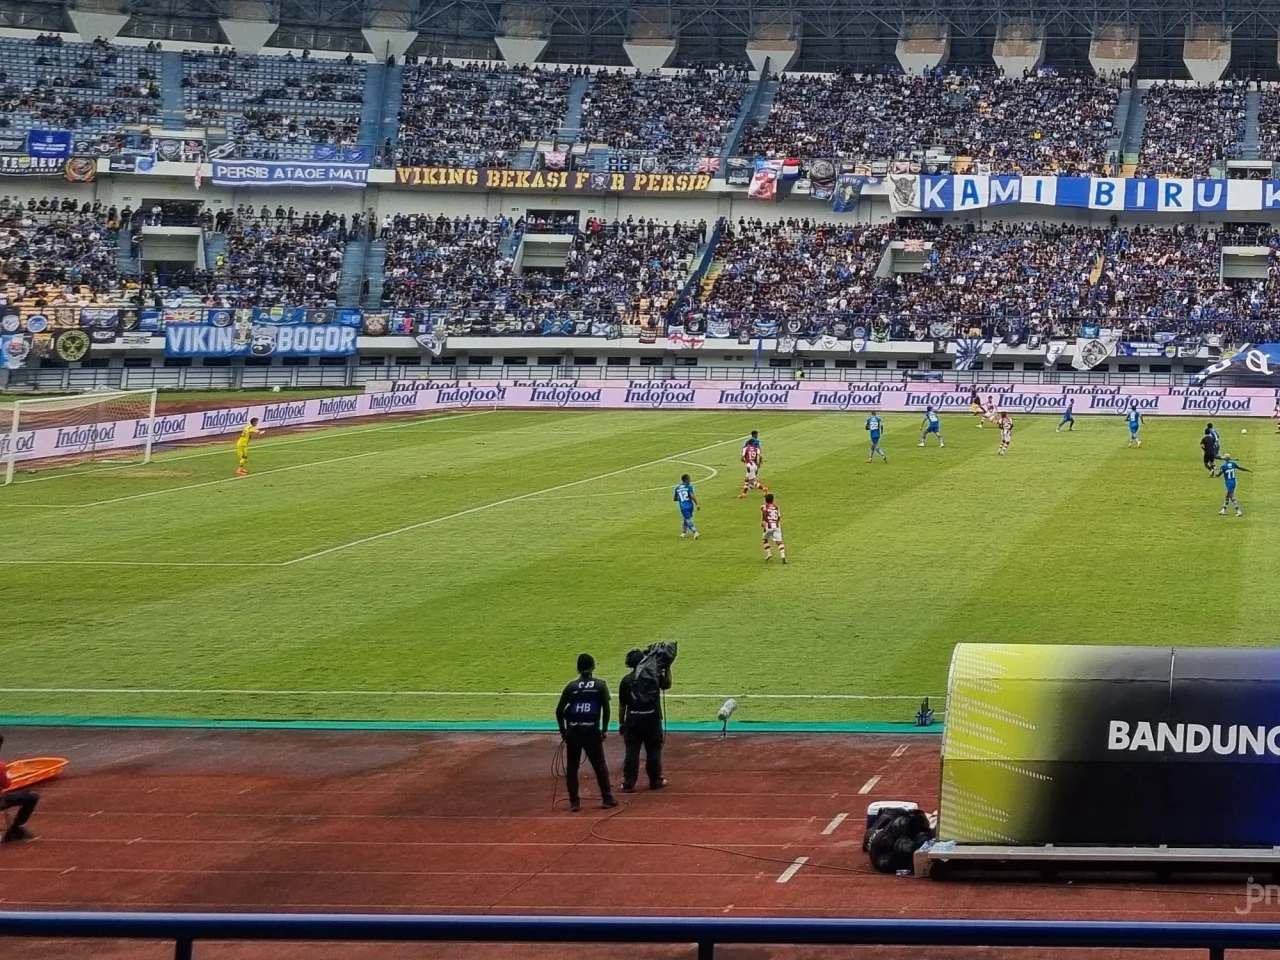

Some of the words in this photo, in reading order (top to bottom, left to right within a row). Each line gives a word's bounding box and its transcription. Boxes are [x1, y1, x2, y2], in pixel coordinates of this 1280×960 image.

[217, 166, 270, 178] PERSIB
[328, 168, 366, 181] MATI
[395, 167, 478, 184] VIKING
[485, 171, 568, 189] BEKASI
[633, 174, 711, 191] PERSIB
[923, 178, 1043, 208] KAMI
[1094, 181, 1222, 207] BIRU
[168, 327, 246, 351] VIKIN
[278, 327, 355, 352] BOGOR
[318, 396, 357, 418] Indofood
[369, 391, 418, 412] Indofood
[437, 387, 506, 407] Indofood
[529, 387, 601, 407] Indofood
[625, 389, 695, 409] Indofood
[718, 390, 789, 409] Indofood
[811, 390, 882, 410] Indofood
[998, 393, 1067, 413] Indofood
[1090, 394, 1159, 414] Indofood
[1182, 395, 1251, 415] Indofood
[200, 408, 248, 434] Indofood
[263, 402, 305, 427] Indofood
[748, 451, 756, 460] 19
[1225, 470, 1236, 479] 77
[678, 490, 690, 502] 12
[767, 508, 778, 520] 36
[575, 703, 591, 713] HB
